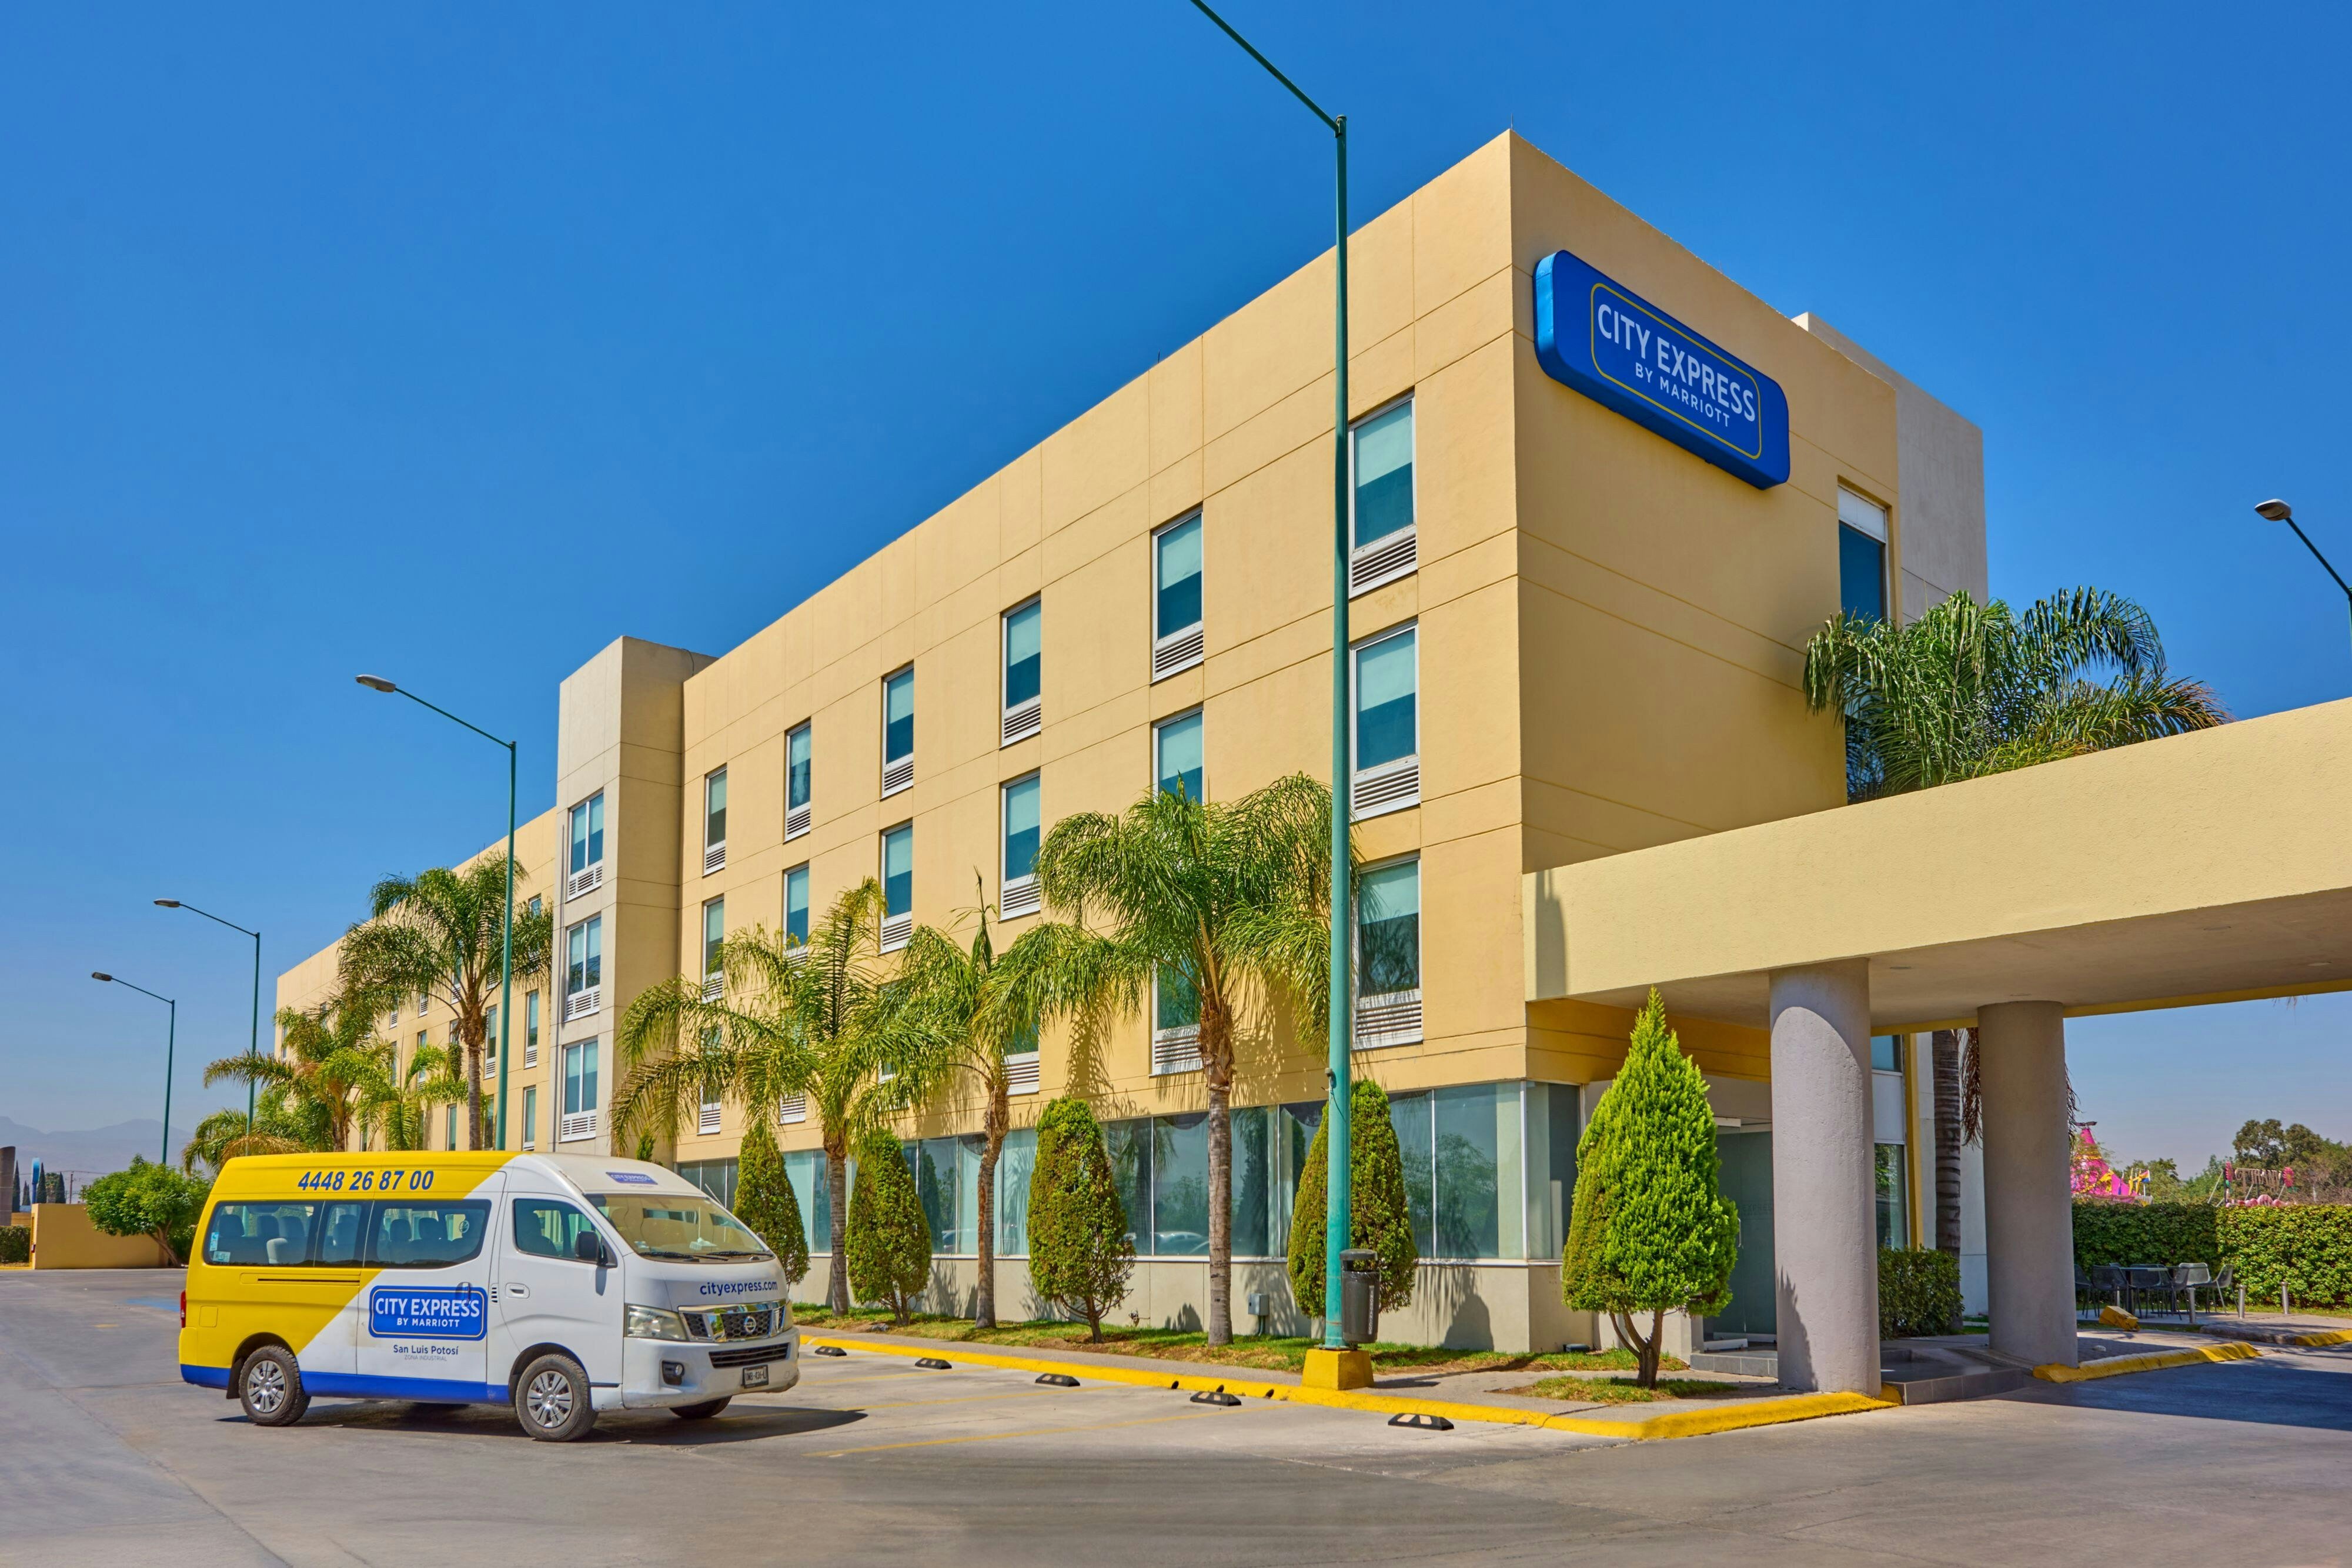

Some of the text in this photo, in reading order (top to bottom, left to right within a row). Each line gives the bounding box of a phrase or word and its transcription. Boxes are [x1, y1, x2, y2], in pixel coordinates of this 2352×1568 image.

[1598, 304, 1755, 422] CITY EXPRESS
[1636, 362, 1730, 427] BY MARRIOTT
[298, 1171, 434, 1191] 4448 26 87 00
[700, 1281, 778, 1296] cityexpress.com
[375, 1298, 480, 1318] CITY EXPRESS
[397, 1318, 460, 1328] BY MARRIOTT
[393, 1345, 459, 1355] San Luis Potosí
